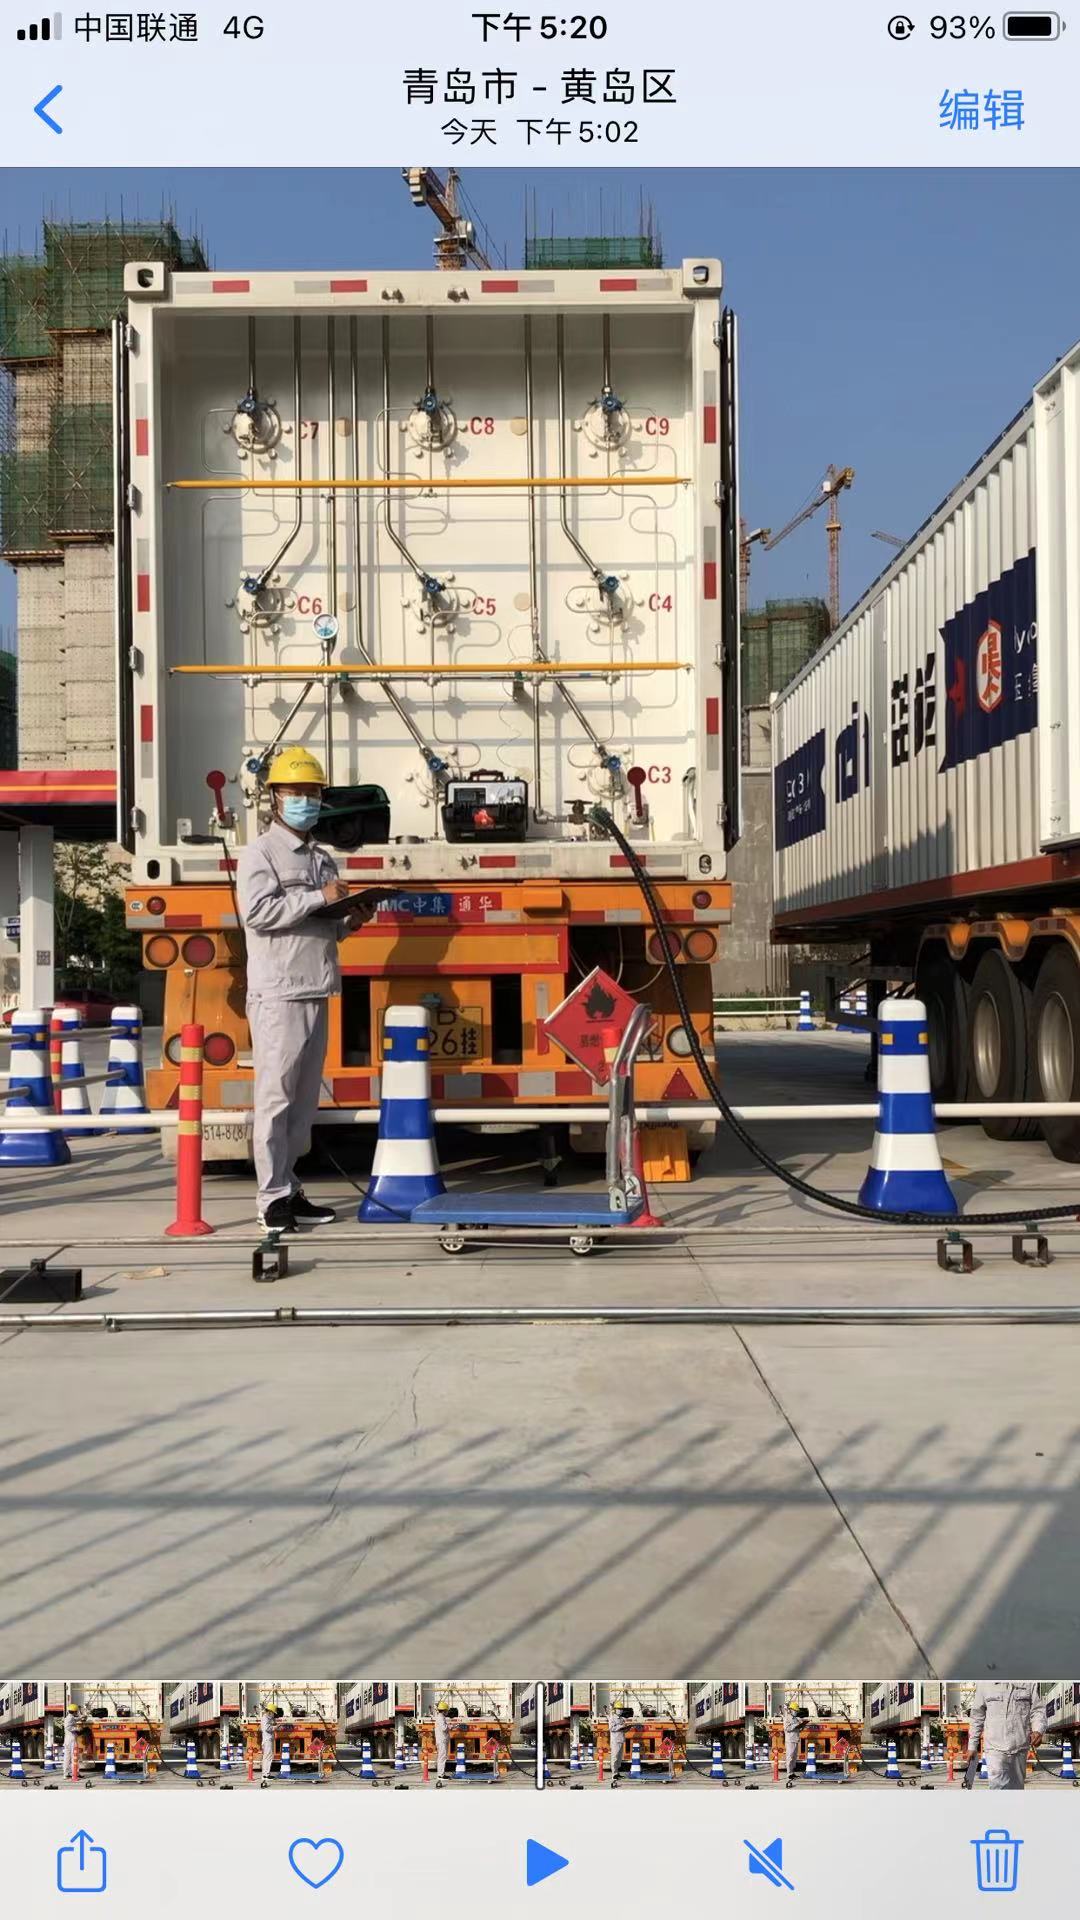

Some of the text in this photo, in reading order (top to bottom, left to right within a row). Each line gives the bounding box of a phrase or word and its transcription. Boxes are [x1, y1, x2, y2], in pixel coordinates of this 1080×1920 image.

[470, 416, 495, 436] C8
[645, 416, 670, 436] C9
[297, 595, 322, 615] C6
[472, 597, 496, 616] C5
[648, 593, 673, 612] C4
[647, 765, 672, 784] C3
